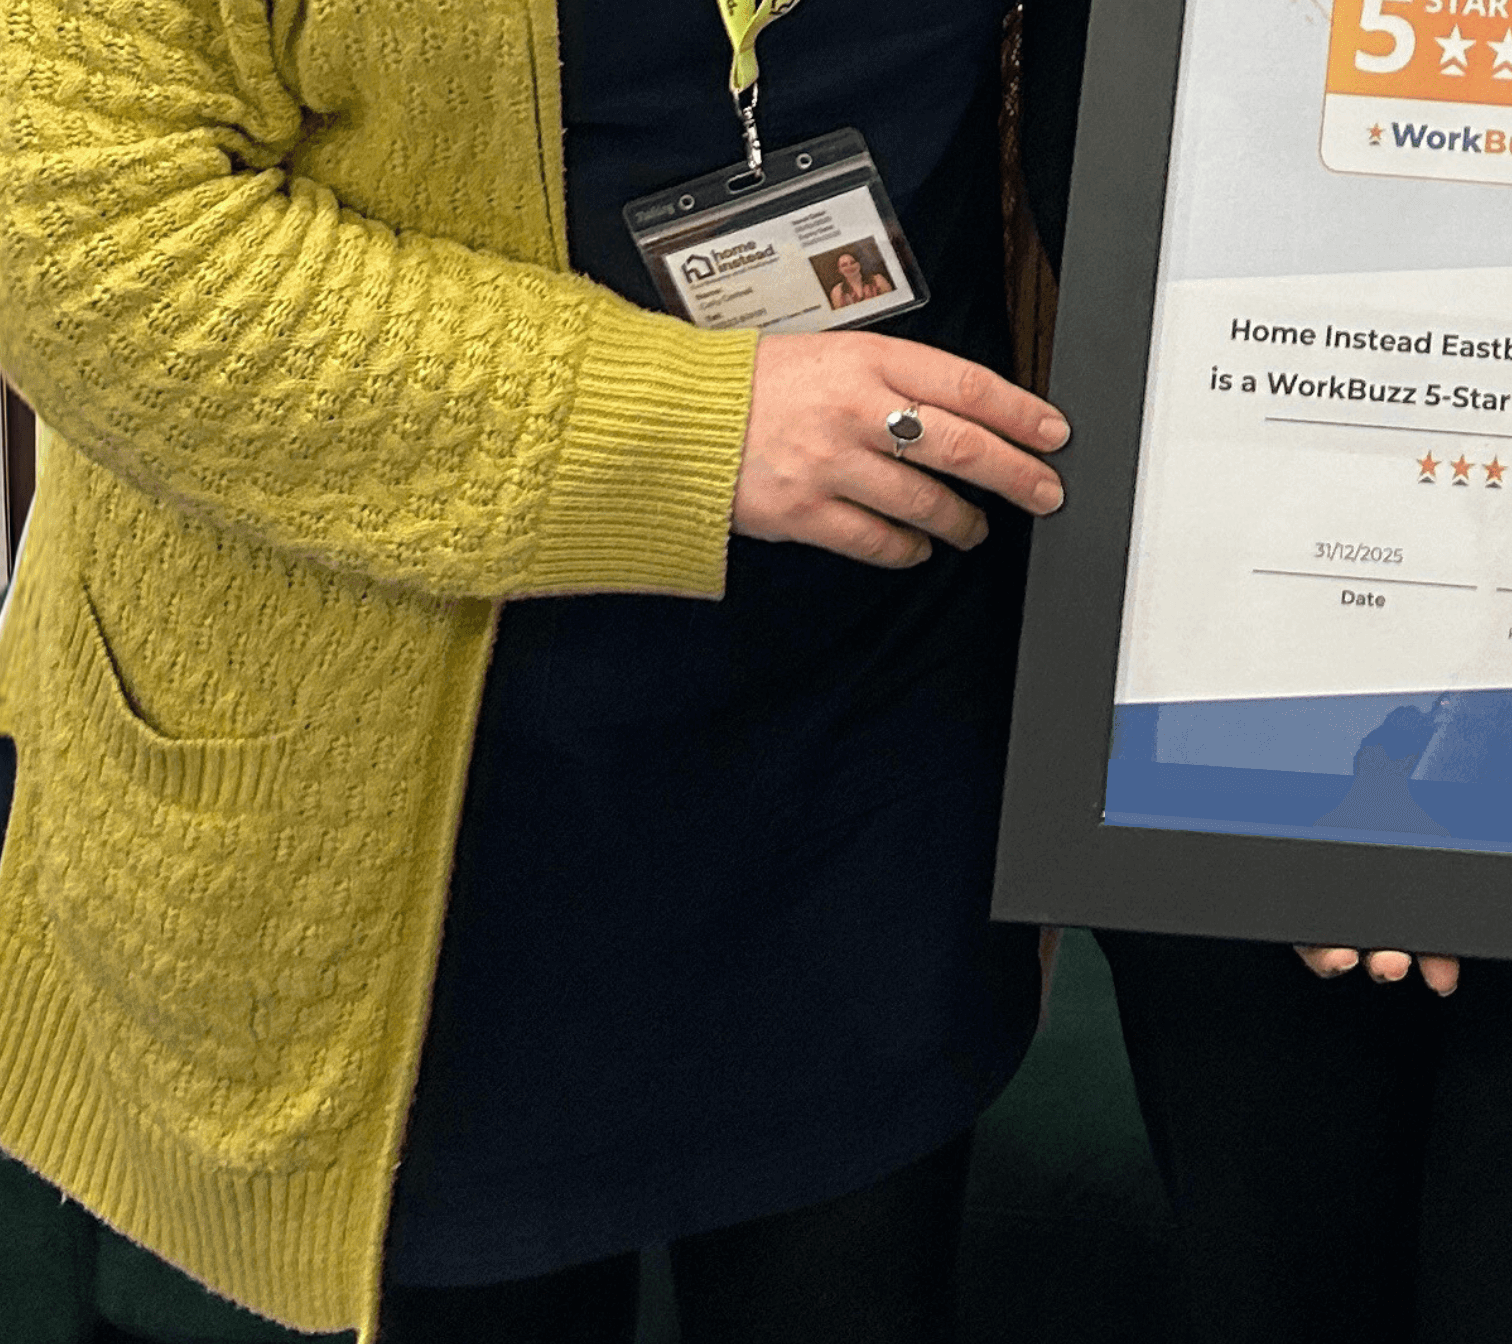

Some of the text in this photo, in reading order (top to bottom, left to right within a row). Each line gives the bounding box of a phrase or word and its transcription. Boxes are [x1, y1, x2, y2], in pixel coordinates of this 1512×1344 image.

[1230, 318, 1317, 346] Home
[1325, 324, 1432, 355] Instead
[1209, 365, 1233, 392] is
[1240, 374, 1256, 393] a
[1267, 372, 1417, 405] WorkBuzz
[1424, 384, 1511, 412] 5-Star
[1314, 541, 1405, 563] 31/12/2025
[1341, 589, 1386, 607] Date
